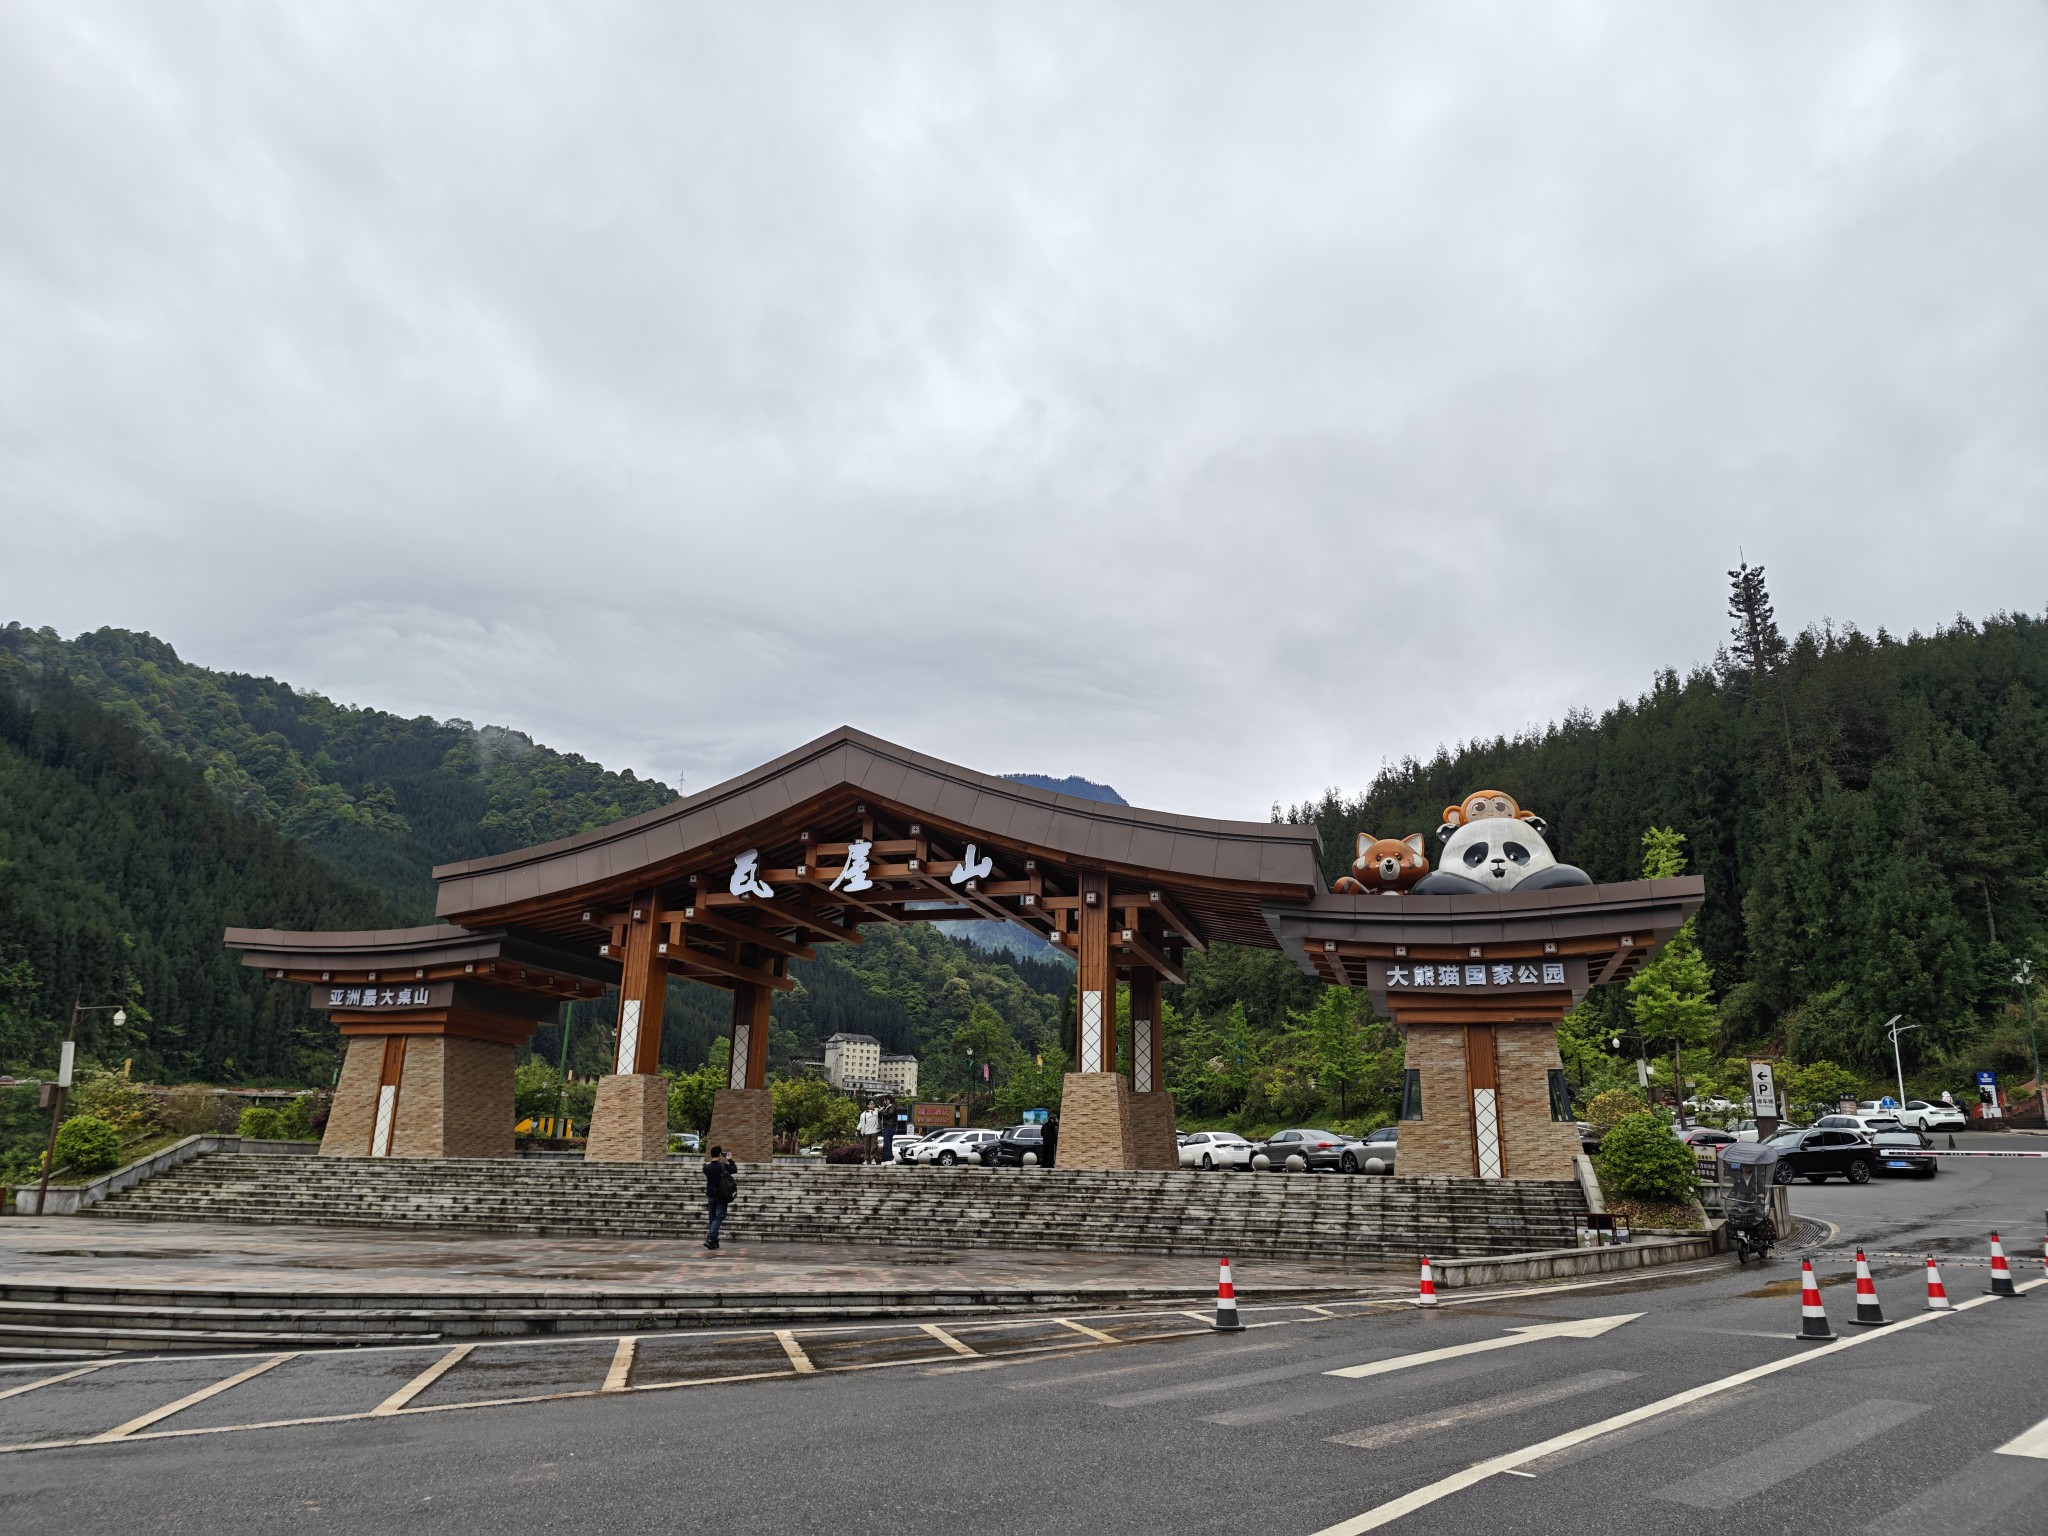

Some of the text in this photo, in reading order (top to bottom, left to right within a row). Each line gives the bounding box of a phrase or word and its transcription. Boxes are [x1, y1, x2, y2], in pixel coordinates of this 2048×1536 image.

[729, 841, 993, 898] 瓦屋山
[1386, 963, 1565, 987] 大熊猫国家公园
[328, 987, 429, 1007] 亚洲最大桌山
[1759, 1084, 1768, 1095] P
